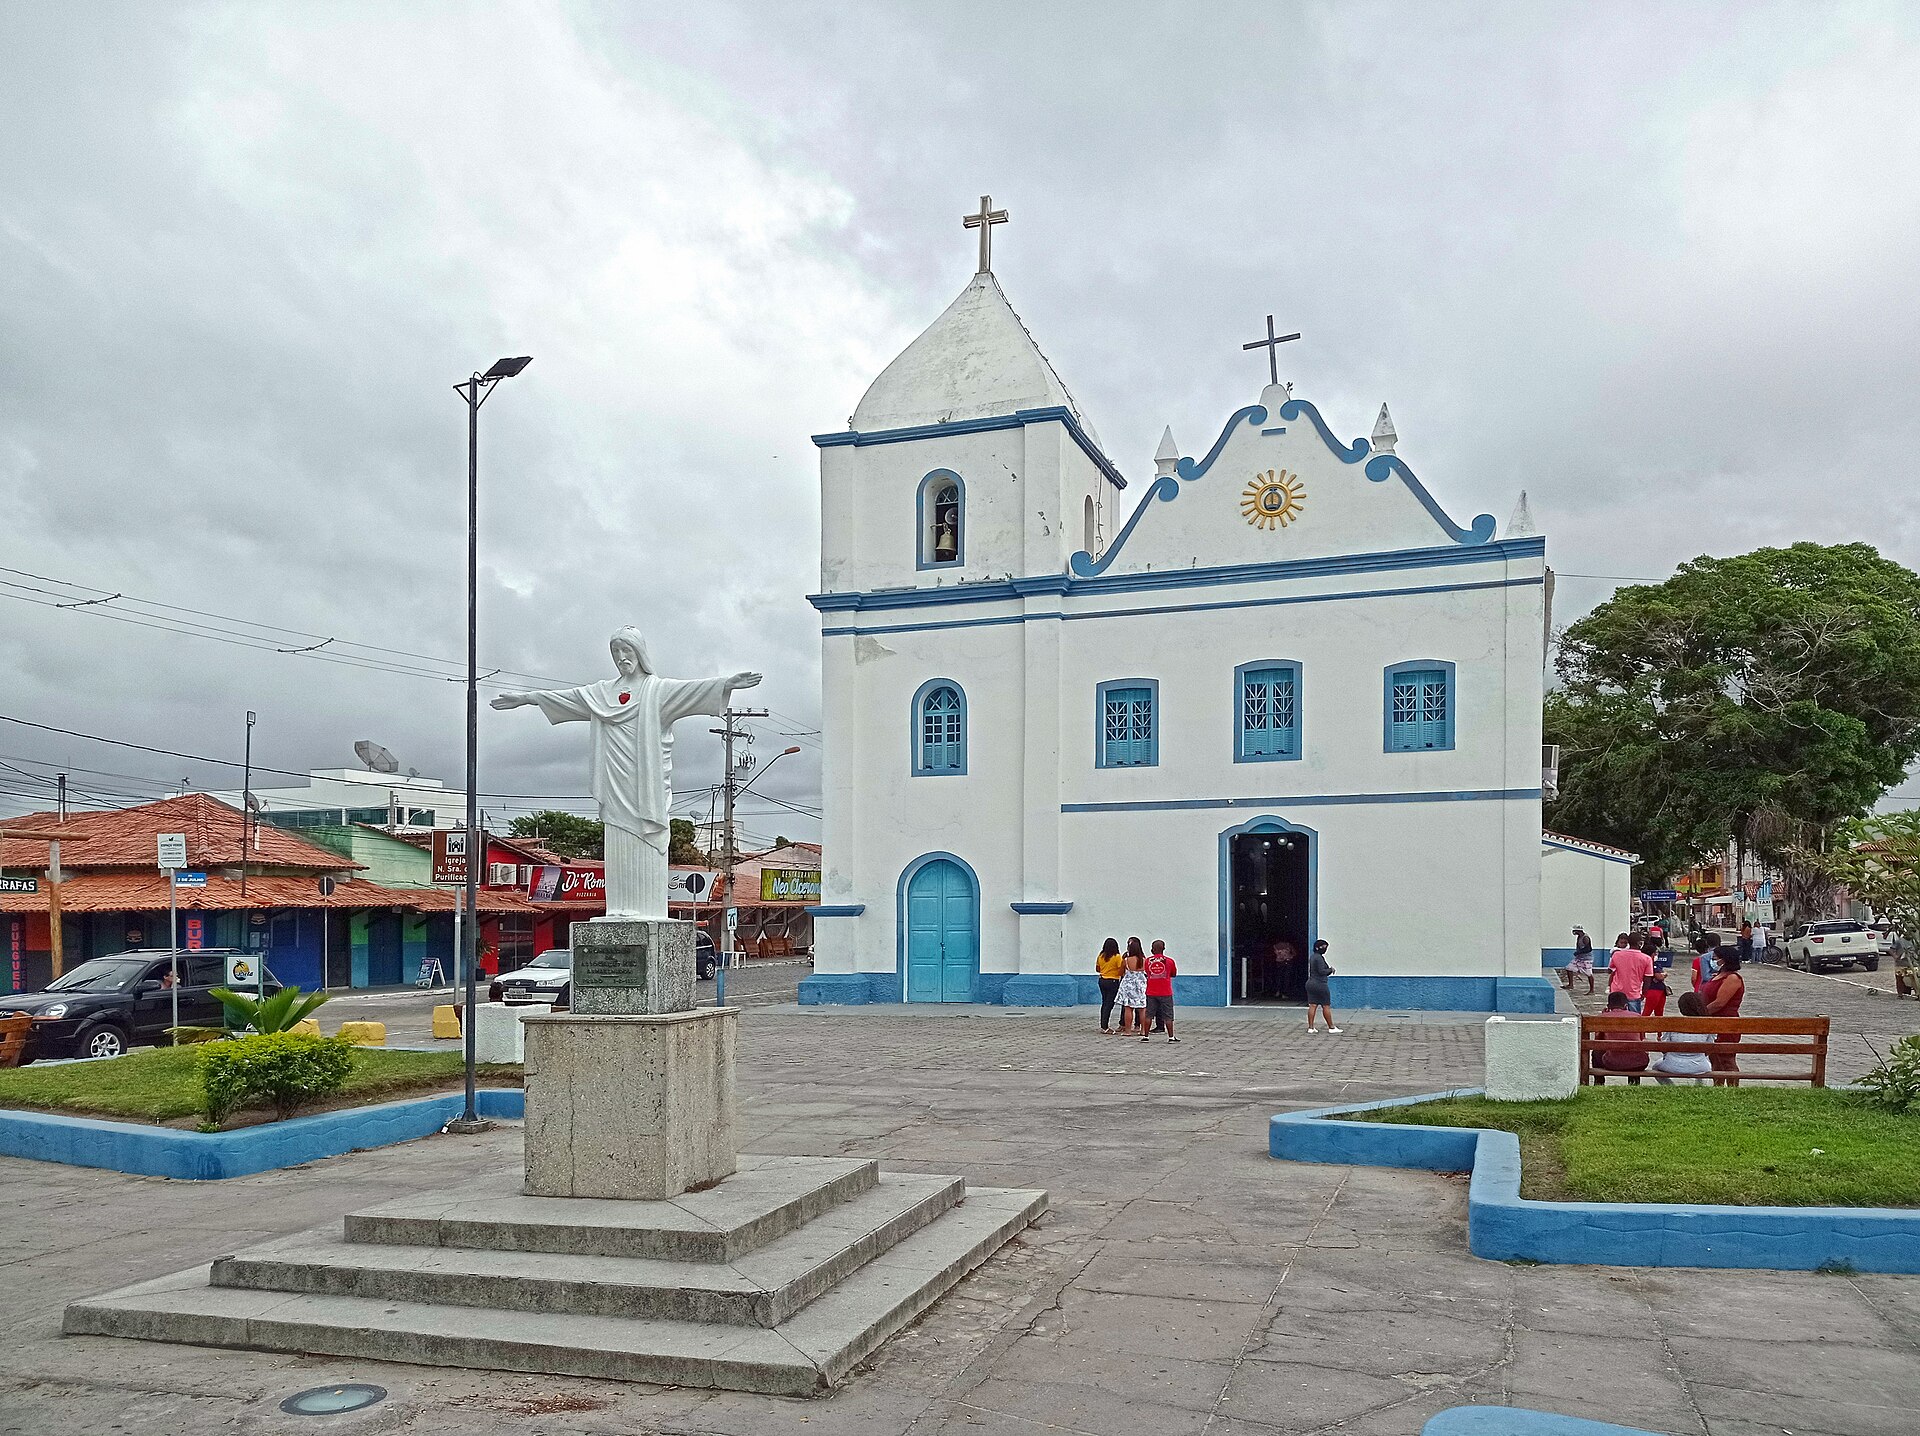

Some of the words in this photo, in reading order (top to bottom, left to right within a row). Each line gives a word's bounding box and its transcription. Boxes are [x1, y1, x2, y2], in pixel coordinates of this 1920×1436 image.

[445, 856, 466, 866] Igreja
[437, 865, 445, 873] N.
[447, 865, 462, 873] Sra.
[781, 870, 817, 879] RESTAURANTE
[435, 873, 468, 882] Purificaç
[561, 870, 580, 892] Di
[0, 879, 35, 891] RAFAS
[772, 877, 789, 895] Neo
[790, 877, 821, 895] Ciceron
[11, 922, 21, 990] BURGUER
